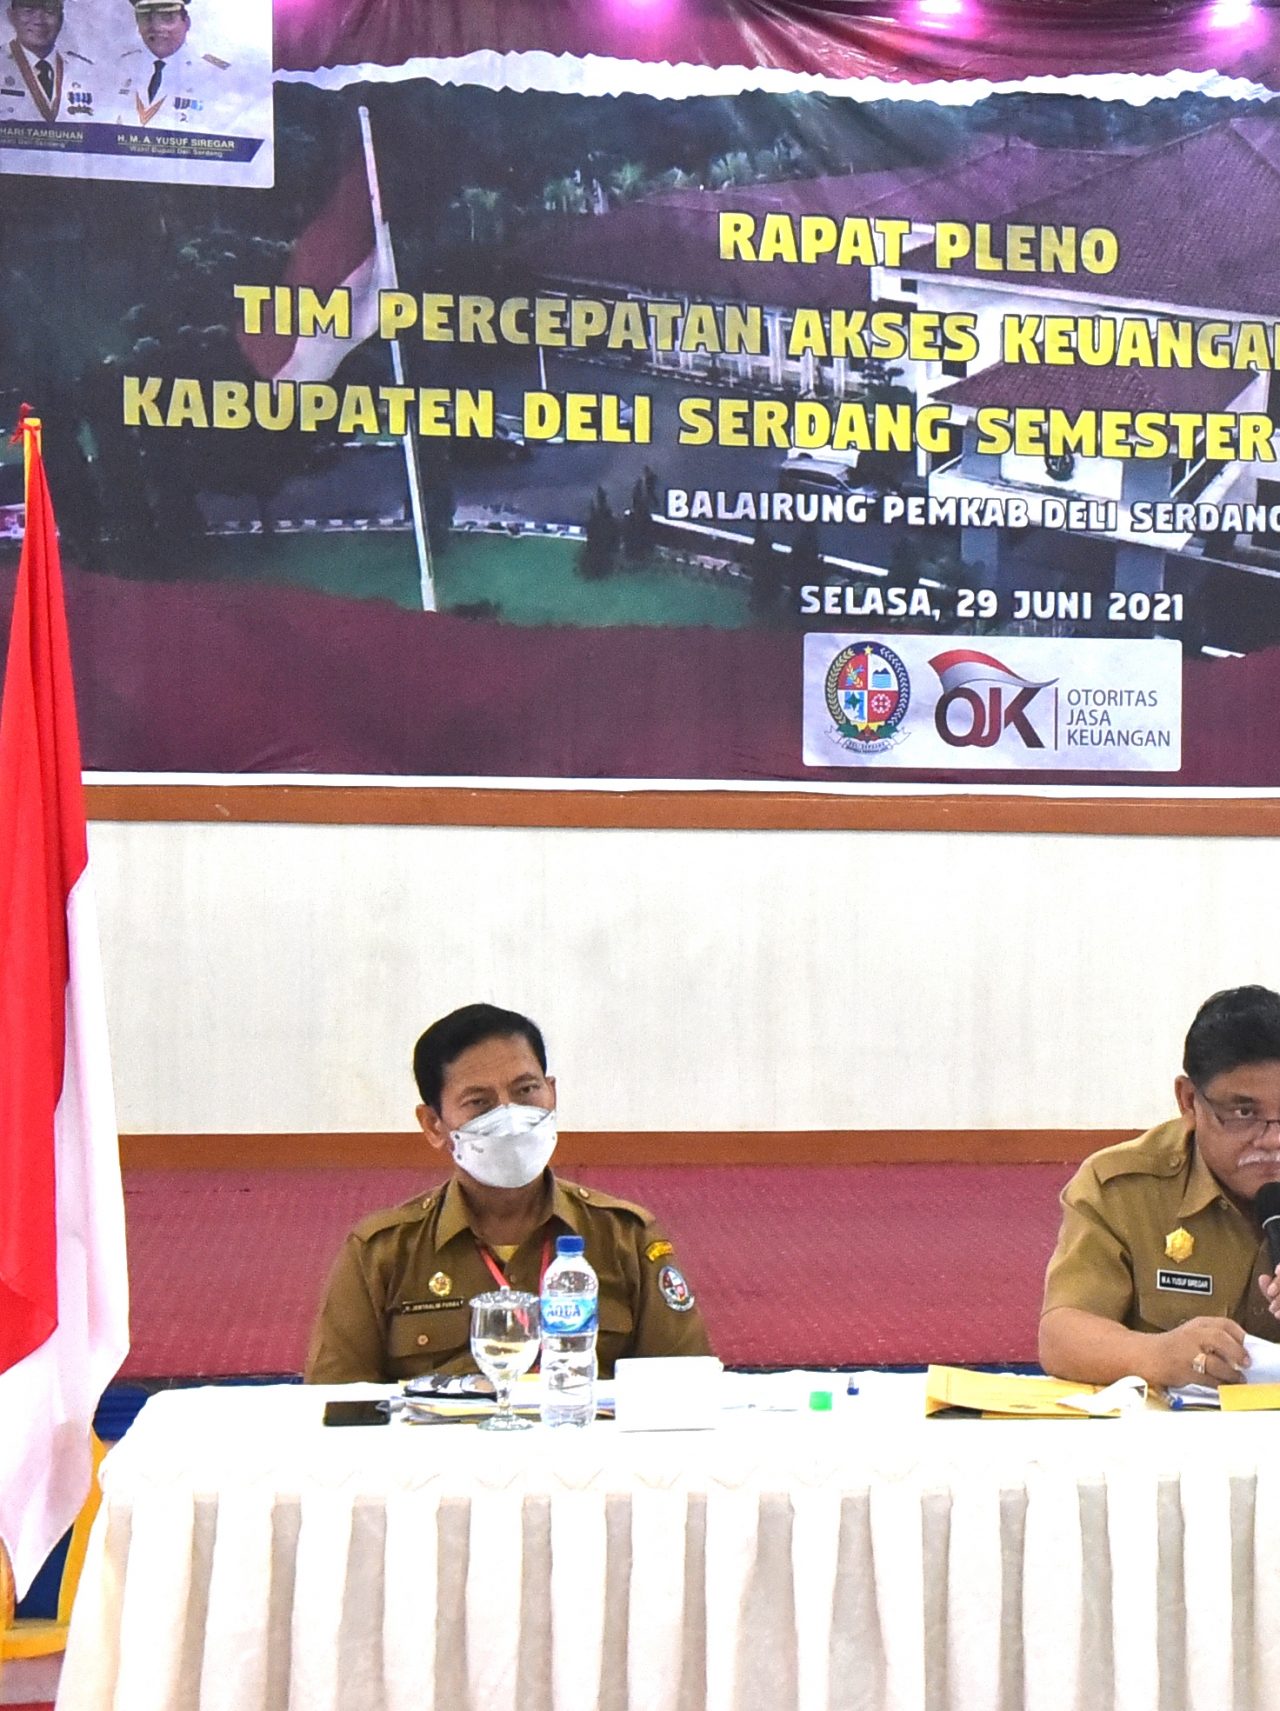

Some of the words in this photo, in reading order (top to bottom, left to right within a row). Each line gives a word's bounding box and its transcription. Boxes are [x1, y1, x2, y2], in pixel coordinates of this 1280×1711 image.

[27, 128, 84, 140] TAMBUNAN
[156, 136, 188, 146] YUSUF
[191, 138, 235, 149] SIREGAR
[718, 211, 910, 267] RAPAT
[935, 221, 1119, 275] PLENO
[233, 283, 350, 339] TIM
[378, 289, 763, 354] PERCEPATAN
[787, 307, 978, 363] AKSES
[123, 375, 494, 439] KABUPATEN
[522, 390, 652, 444] DELI
[677, 398, 952, 453] SERDANG
[975, 406, 1277, 463] SEMESTER
[666, 488, 869, 524] BALAIRUNG
[883, 494, 1029, 528] PEMKAB
[1043, 499, 1118, 531] DELI
[801, 584, 941, 622] SELASA,
[957, 590, 998, 619] 29
[1012, 591, 1092, 622] JUNI
[1108, 593, 1186, 622] 2021
[1067, 688, 1158, 707] OTORITAS
[934, 686, 1046, 749] OJK
[1066, 708, 1111, 727] JASA
[1067, 729, 1171, 748] KEUANGAN
[547, 1304, 581, 1319] AQUA
